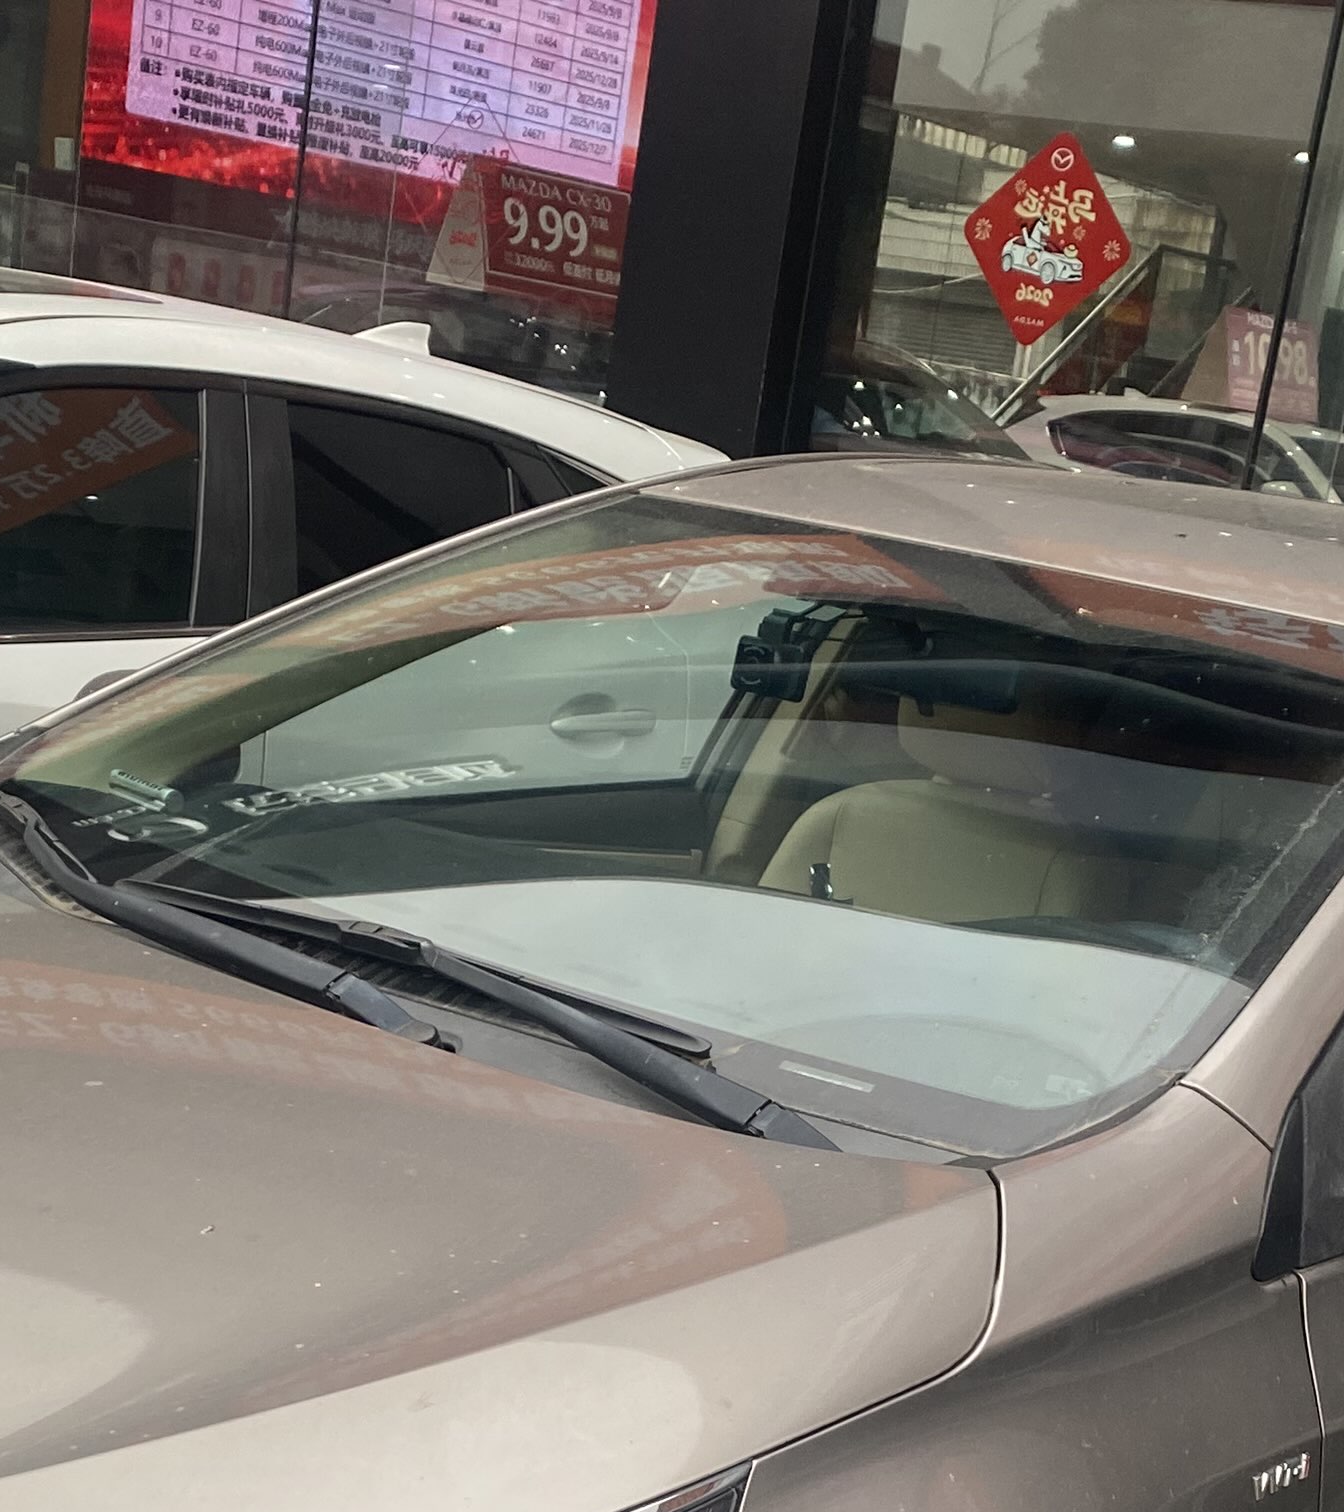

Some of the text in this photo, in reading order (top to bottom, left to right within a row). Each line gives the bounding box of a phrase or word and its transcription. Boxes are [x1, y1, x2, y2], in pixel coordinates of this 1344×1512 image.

[191, 18, 221, 36] EZ-60
[151, 35, 163, 49] 10
[501, 173, 612, 212] MAZDA CX-30
[504, 196, 588, 257] 9.99
